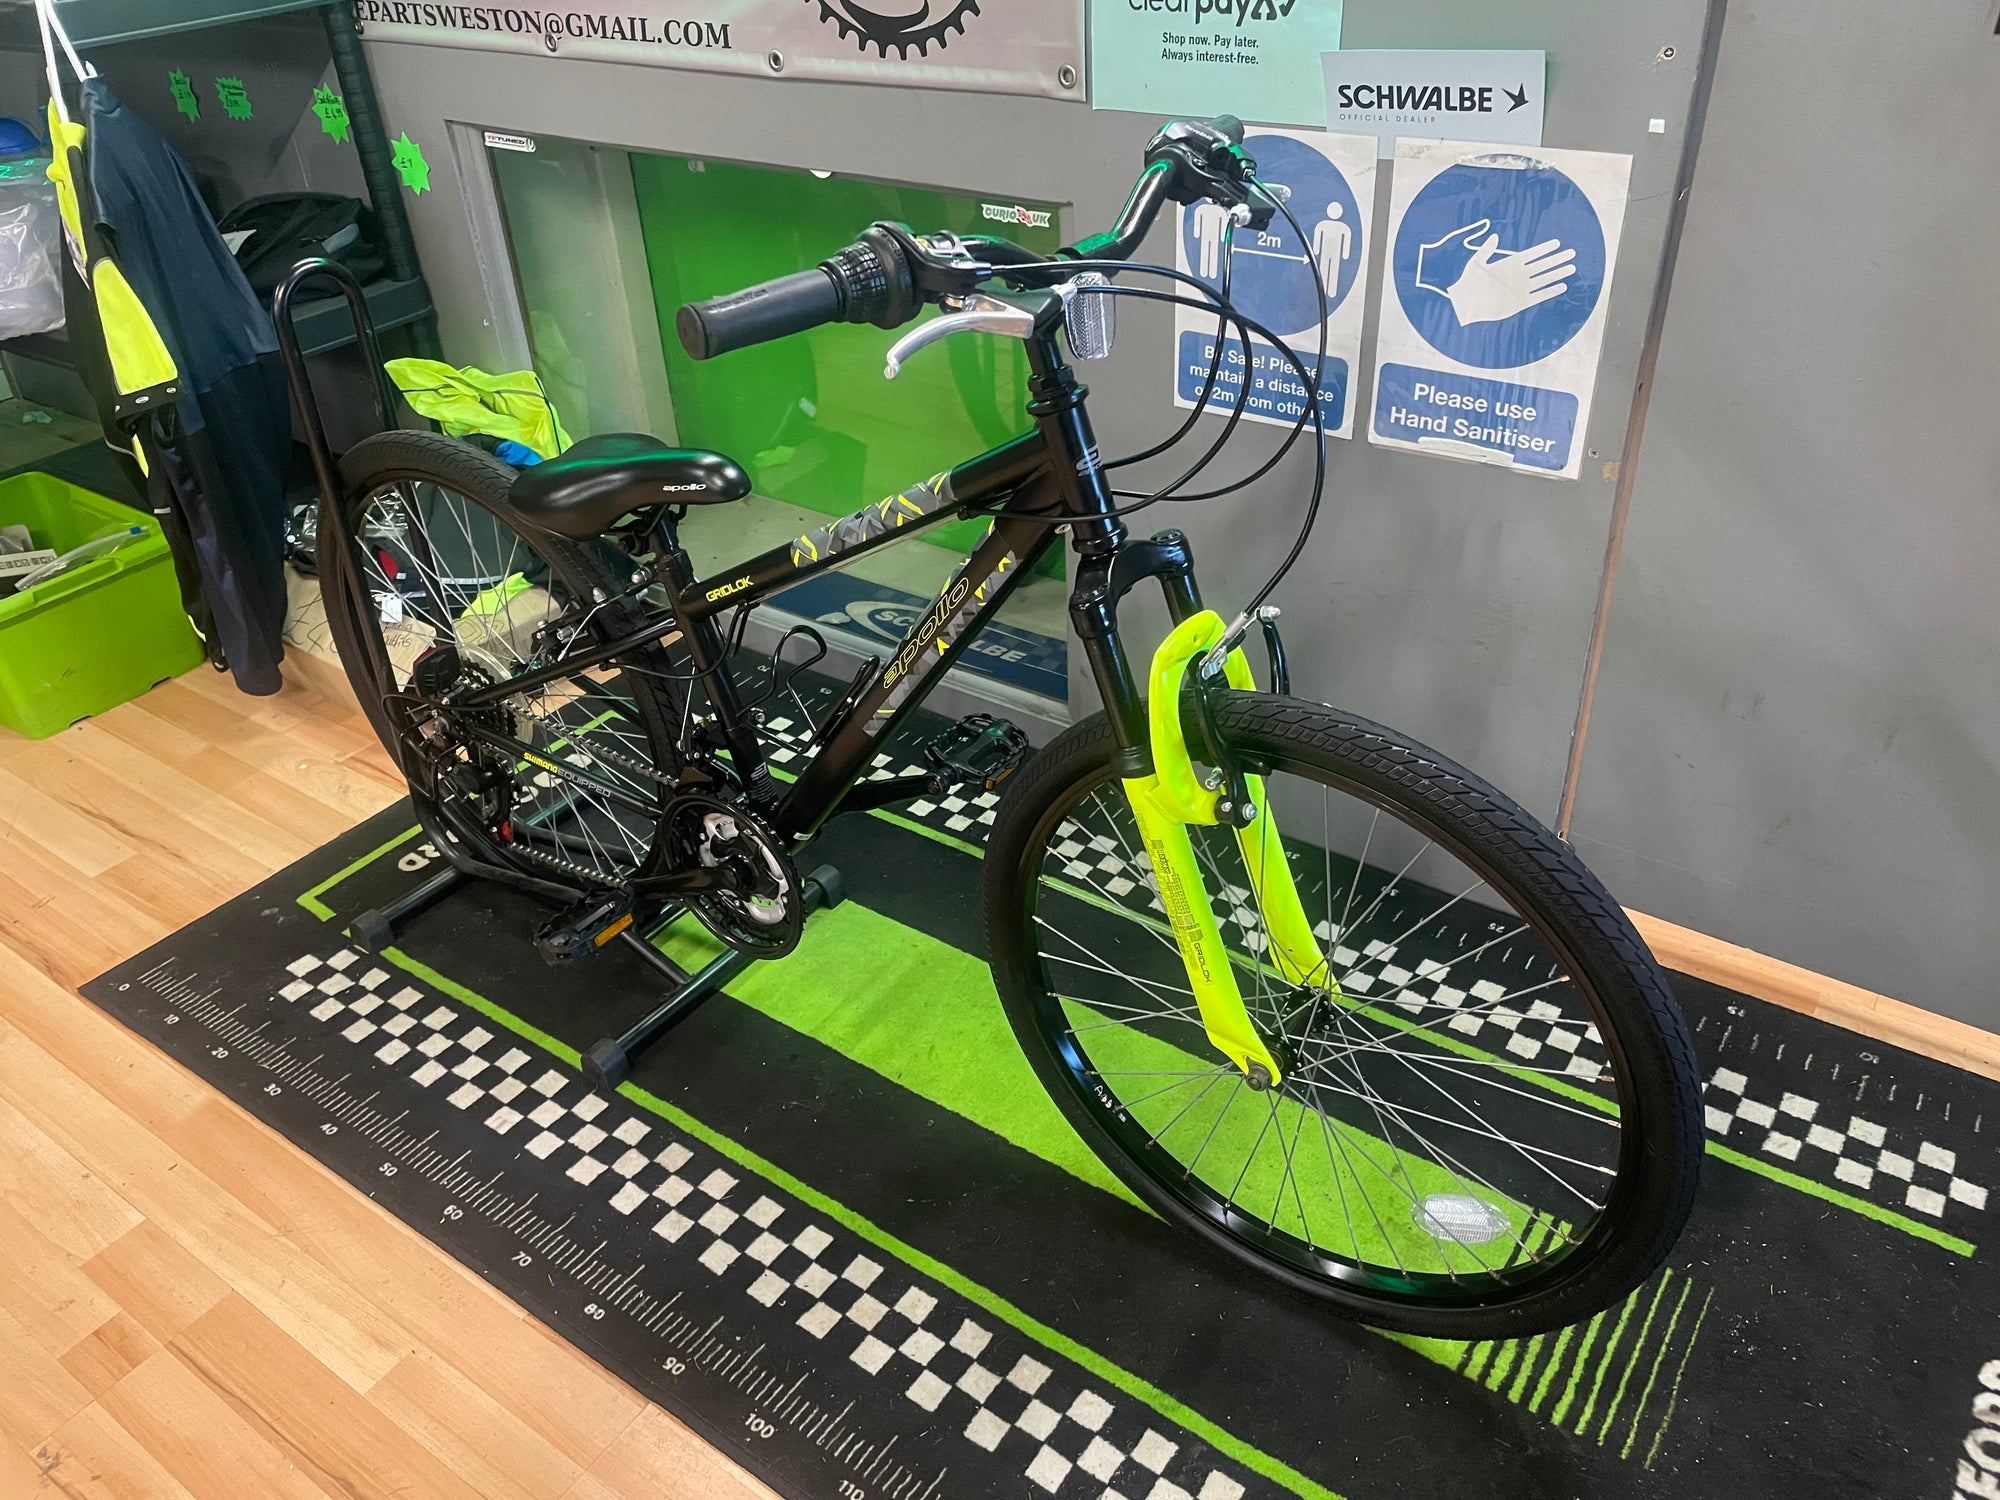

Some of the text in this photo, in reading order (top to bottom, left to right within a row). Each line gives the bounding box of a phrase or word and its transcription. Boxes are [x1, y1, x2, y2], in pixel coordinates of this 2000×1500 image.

[1162, 32, 1259, 49] Shop now. Pay later.
[1161, 48, 1259, 65] Always interest-free.
[1338, 84, 1493, 112] SCHWALBE
[1339, 113, 1436, 123] OFFICIAL DEALER
[1257, 231, 1282, 249] 2m
[1228, 349, 1265, 369] Sae!
[1255, 378, 1265, 389] a
[1212, 386, 1235, 403] 2m
[1413, 382, 1537, 421] Please use
[1390, 406, 1556, 453] Hand Sanitiser
[662, 483, 707, 492] apollo
[705, 575, 754, 602] GRIDLOK
[883, 577, 969, 689] apollo
[523, 752, 559, 774] SHIMANO
[558, 768, 611, 797] EQUIPPED
[163, 1013, 180, 1025] 10
[211, 1046, 230, 1060] 20
[263, 1082, 283, 1097] 30
[319, 1122, 339, 1137] 40
[378, 1162, 398, 1177] 50
[443, 1205, 464, 1221] 60
[511, 1250, 533, 1268] 70
[583, 1303, 606, 1321] 80
[662, 1356, 687, 1376] 90
[744, 1412, 775, 1439] 100
[838, 1478, 866, 1500] 110
